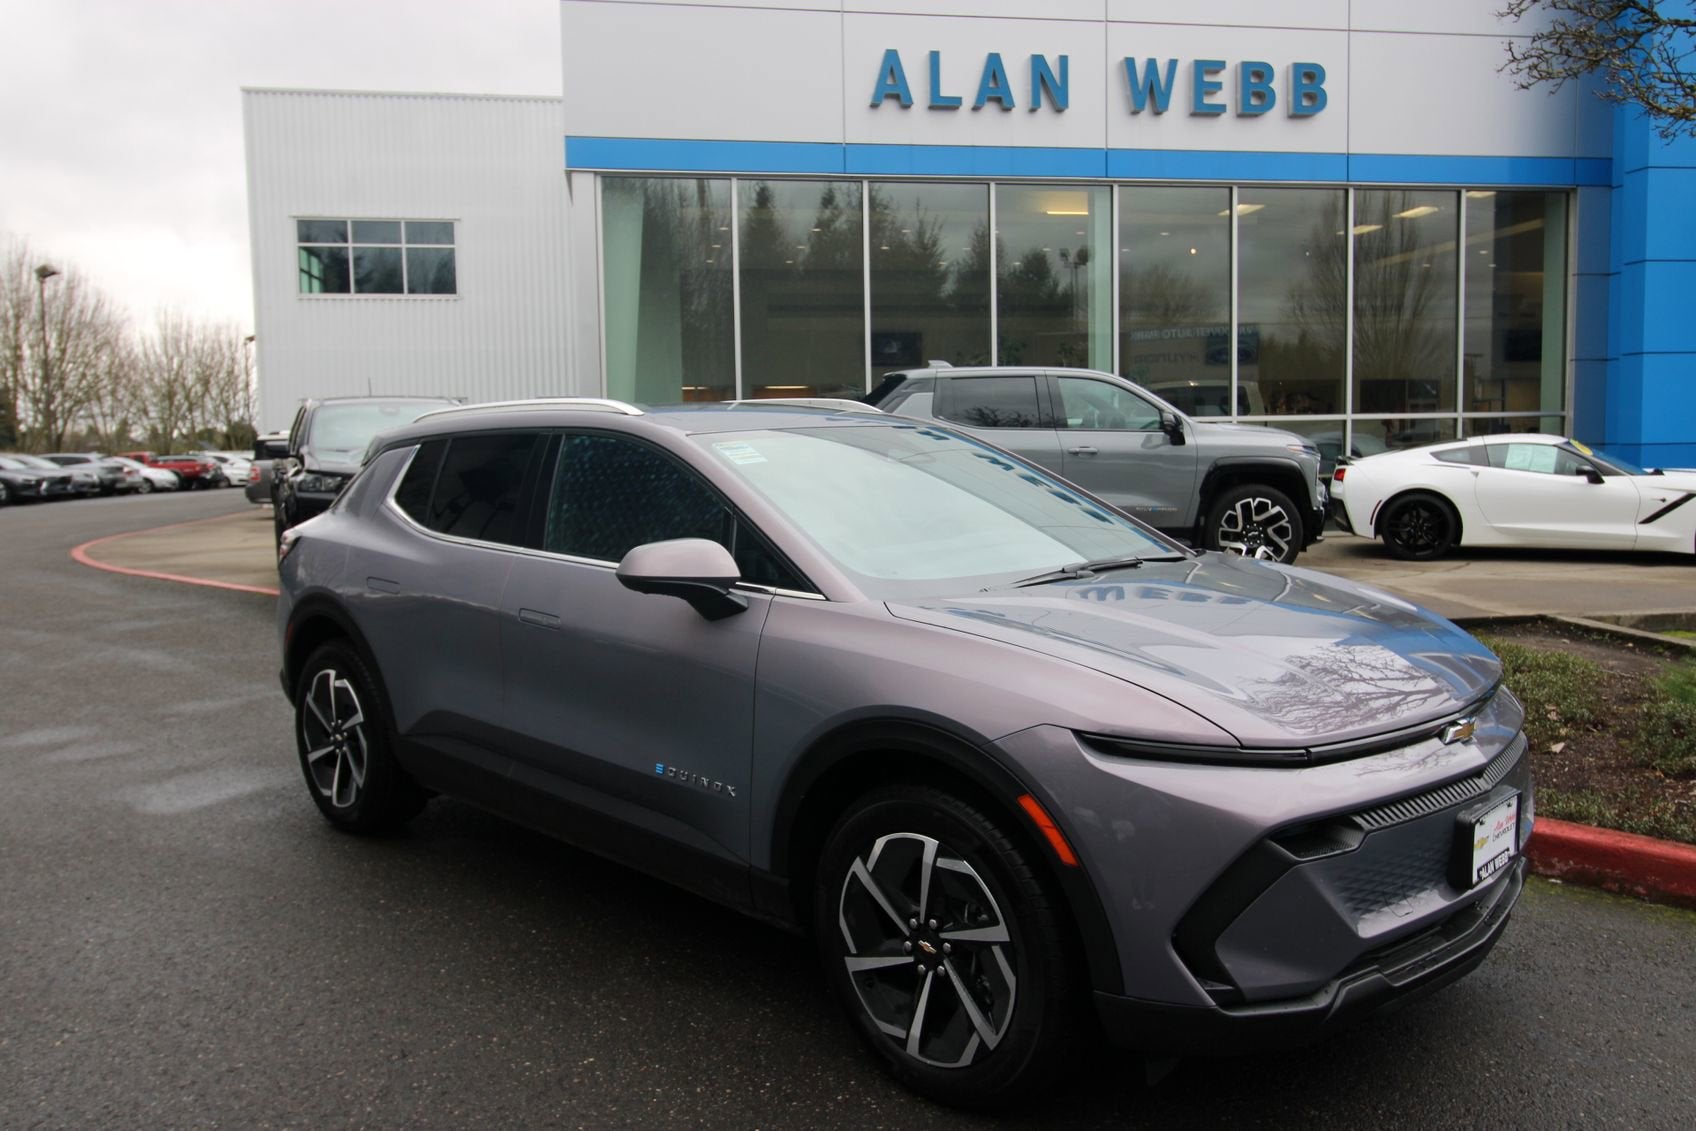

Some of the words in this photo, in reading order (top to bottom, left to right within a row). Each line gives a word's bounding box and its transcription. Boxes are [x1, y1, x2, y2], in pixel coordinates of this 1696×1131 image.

[870, 48, 1069, 112] ALAN
[1122, 56, 1328, 118] WEBB
[655, 762, 737, 797] EQUINOX
